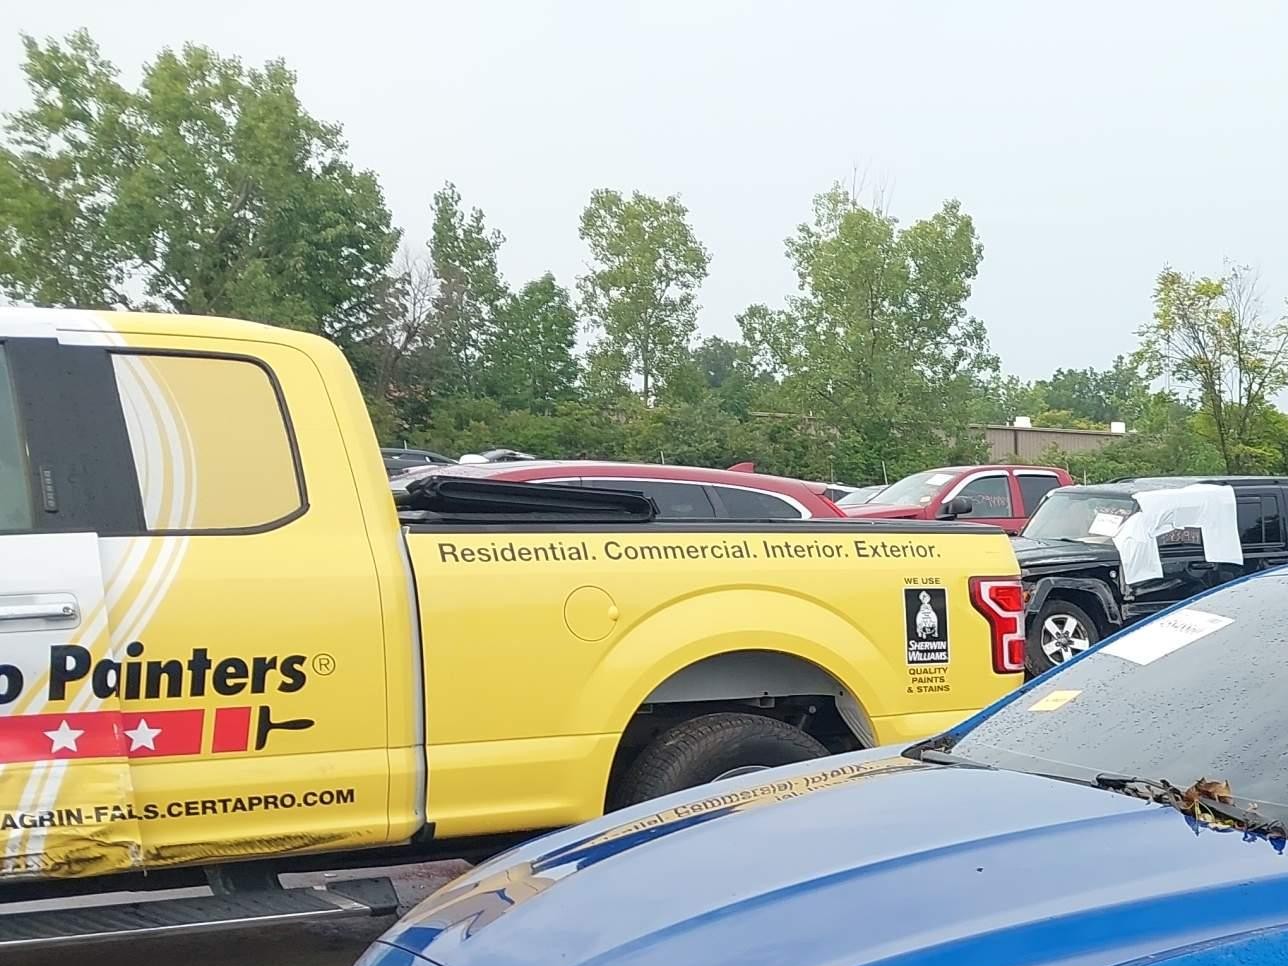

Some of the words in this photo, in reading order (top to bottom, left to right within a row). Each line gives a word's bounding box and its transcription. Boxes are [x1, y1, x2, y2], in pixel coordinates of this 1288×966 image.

[438, 541, 597, 563] Residential.
[604, 540, 757, 561] Commercial.
[763, 540, 849, 560] Interior.
[854, 540, 941, 559] Exterior.
[903, 577, 919, 585] WE
[921, 577, 941, 585] USE
[908, 667, 949, 676] QUALITY
[911, 676, 946, 685] PAINTS
[916, 684, 951, 694] STAINS
